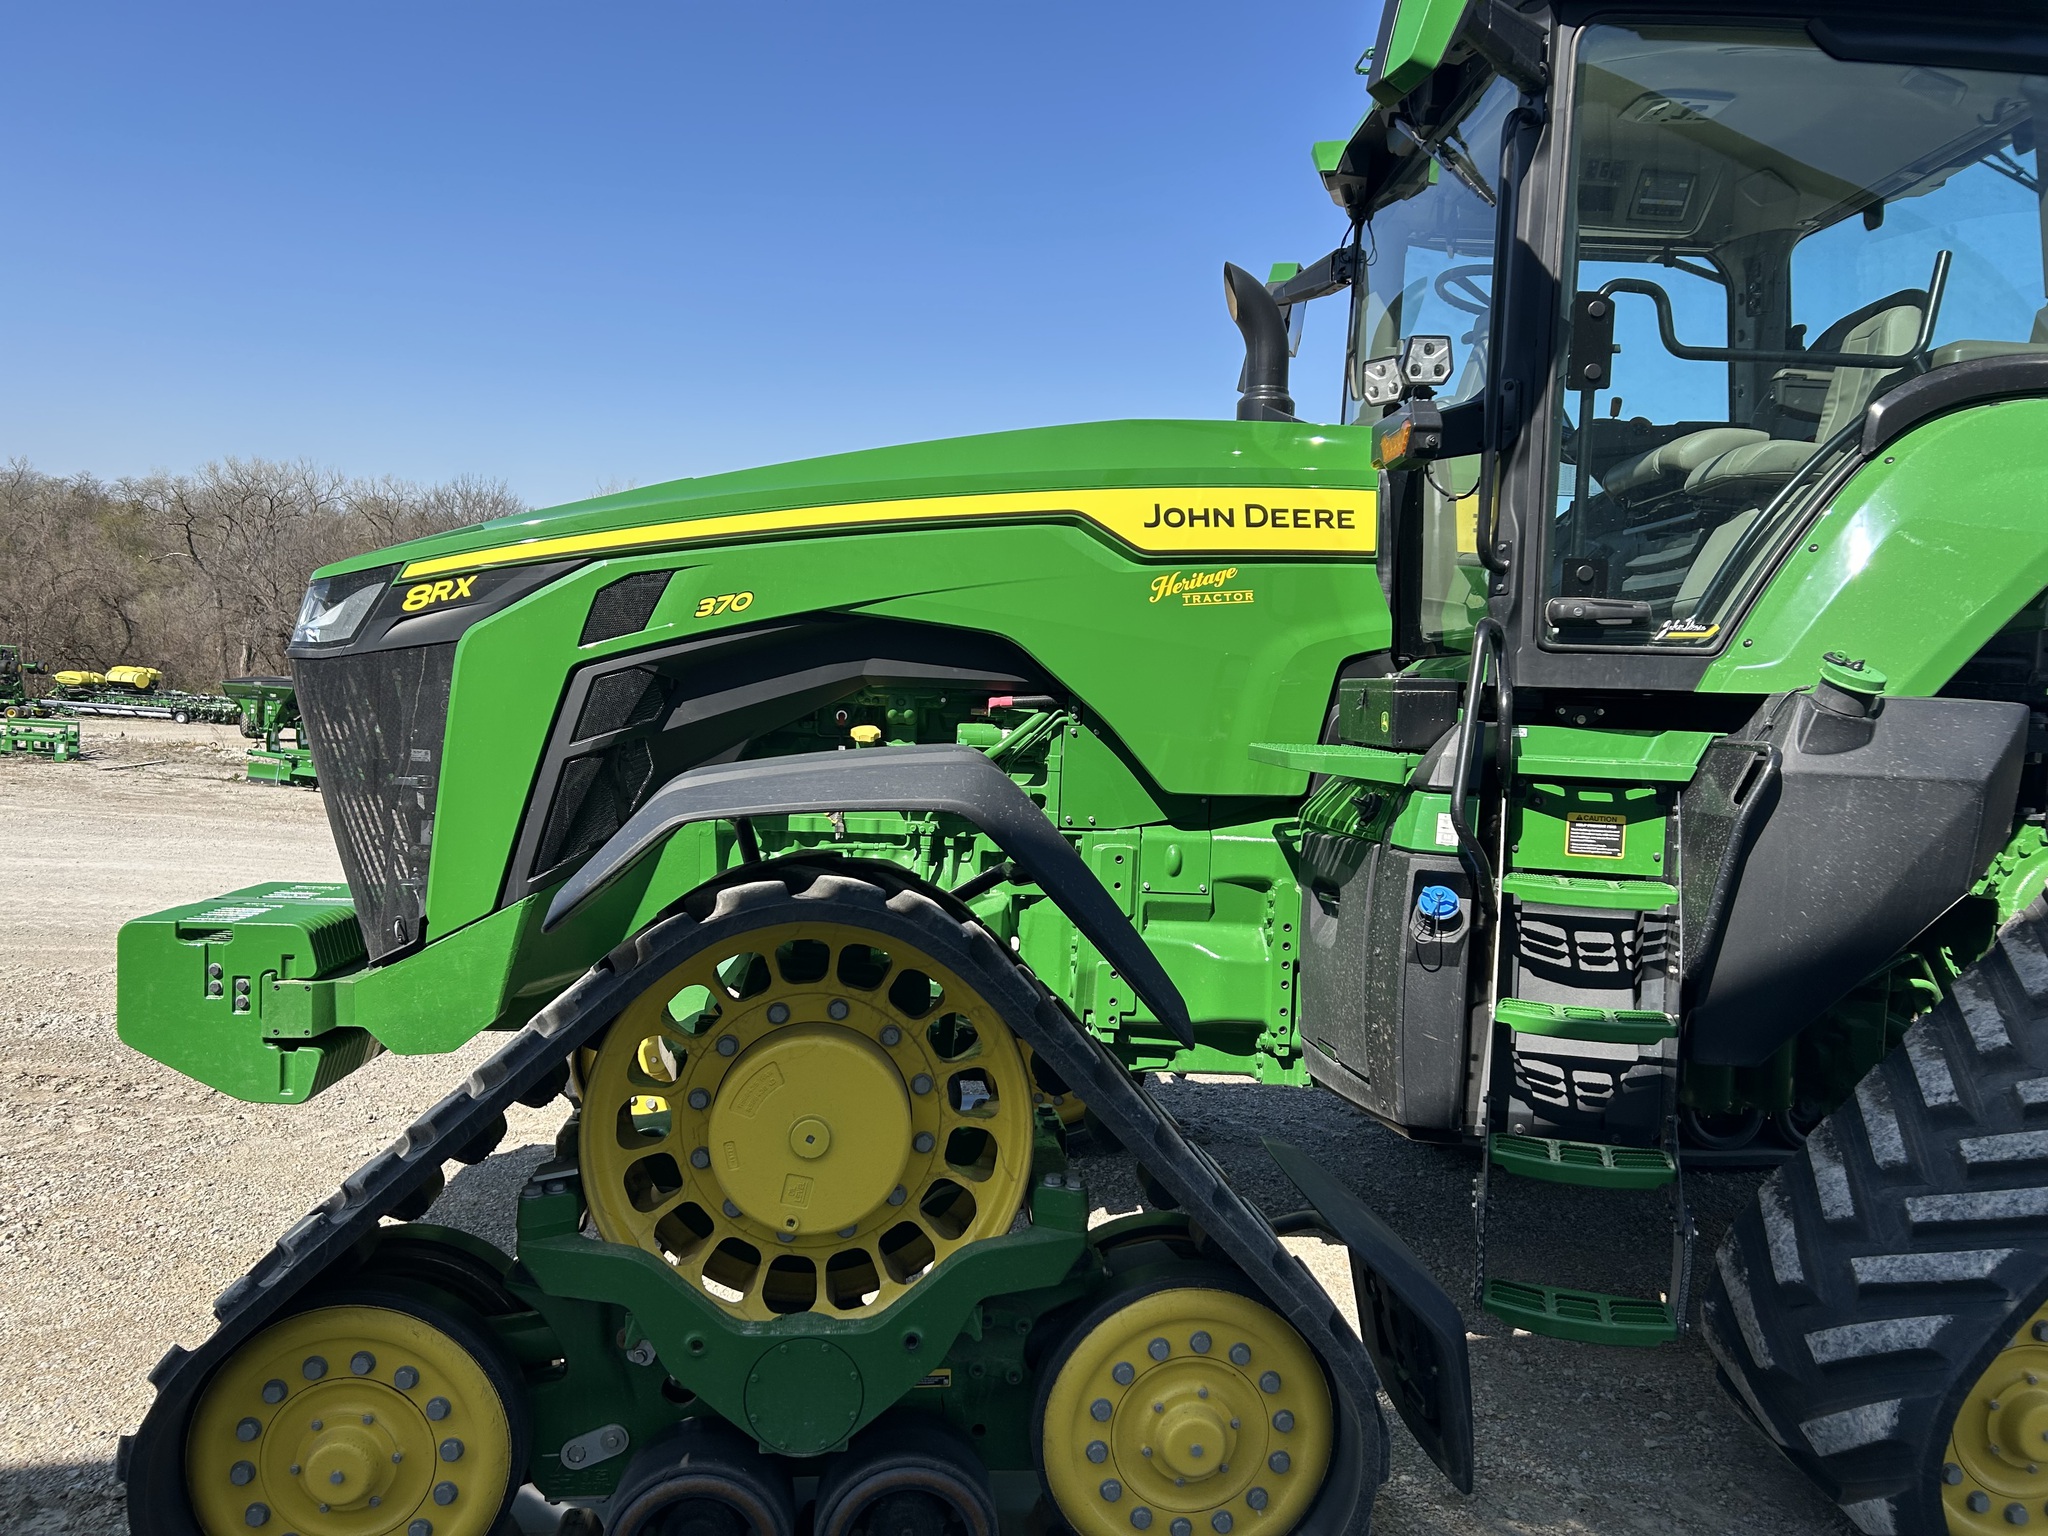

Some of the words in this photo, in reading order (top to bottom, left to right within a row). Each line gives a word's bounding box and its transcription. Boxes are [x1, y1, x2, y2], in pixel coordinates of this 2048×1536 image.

[1144, 503, 1235, 528] JOHN
[1245, 503, 1355, 529] DEERE
[402, 575, 478, 612] 8RX
[1149, 567, 1238, 602] Heritage
[694, 591, 754, 618] 370
[1183, 592, 1253, 604] TRACTOR
[1583, 814, 1618, 823] CAUTION
